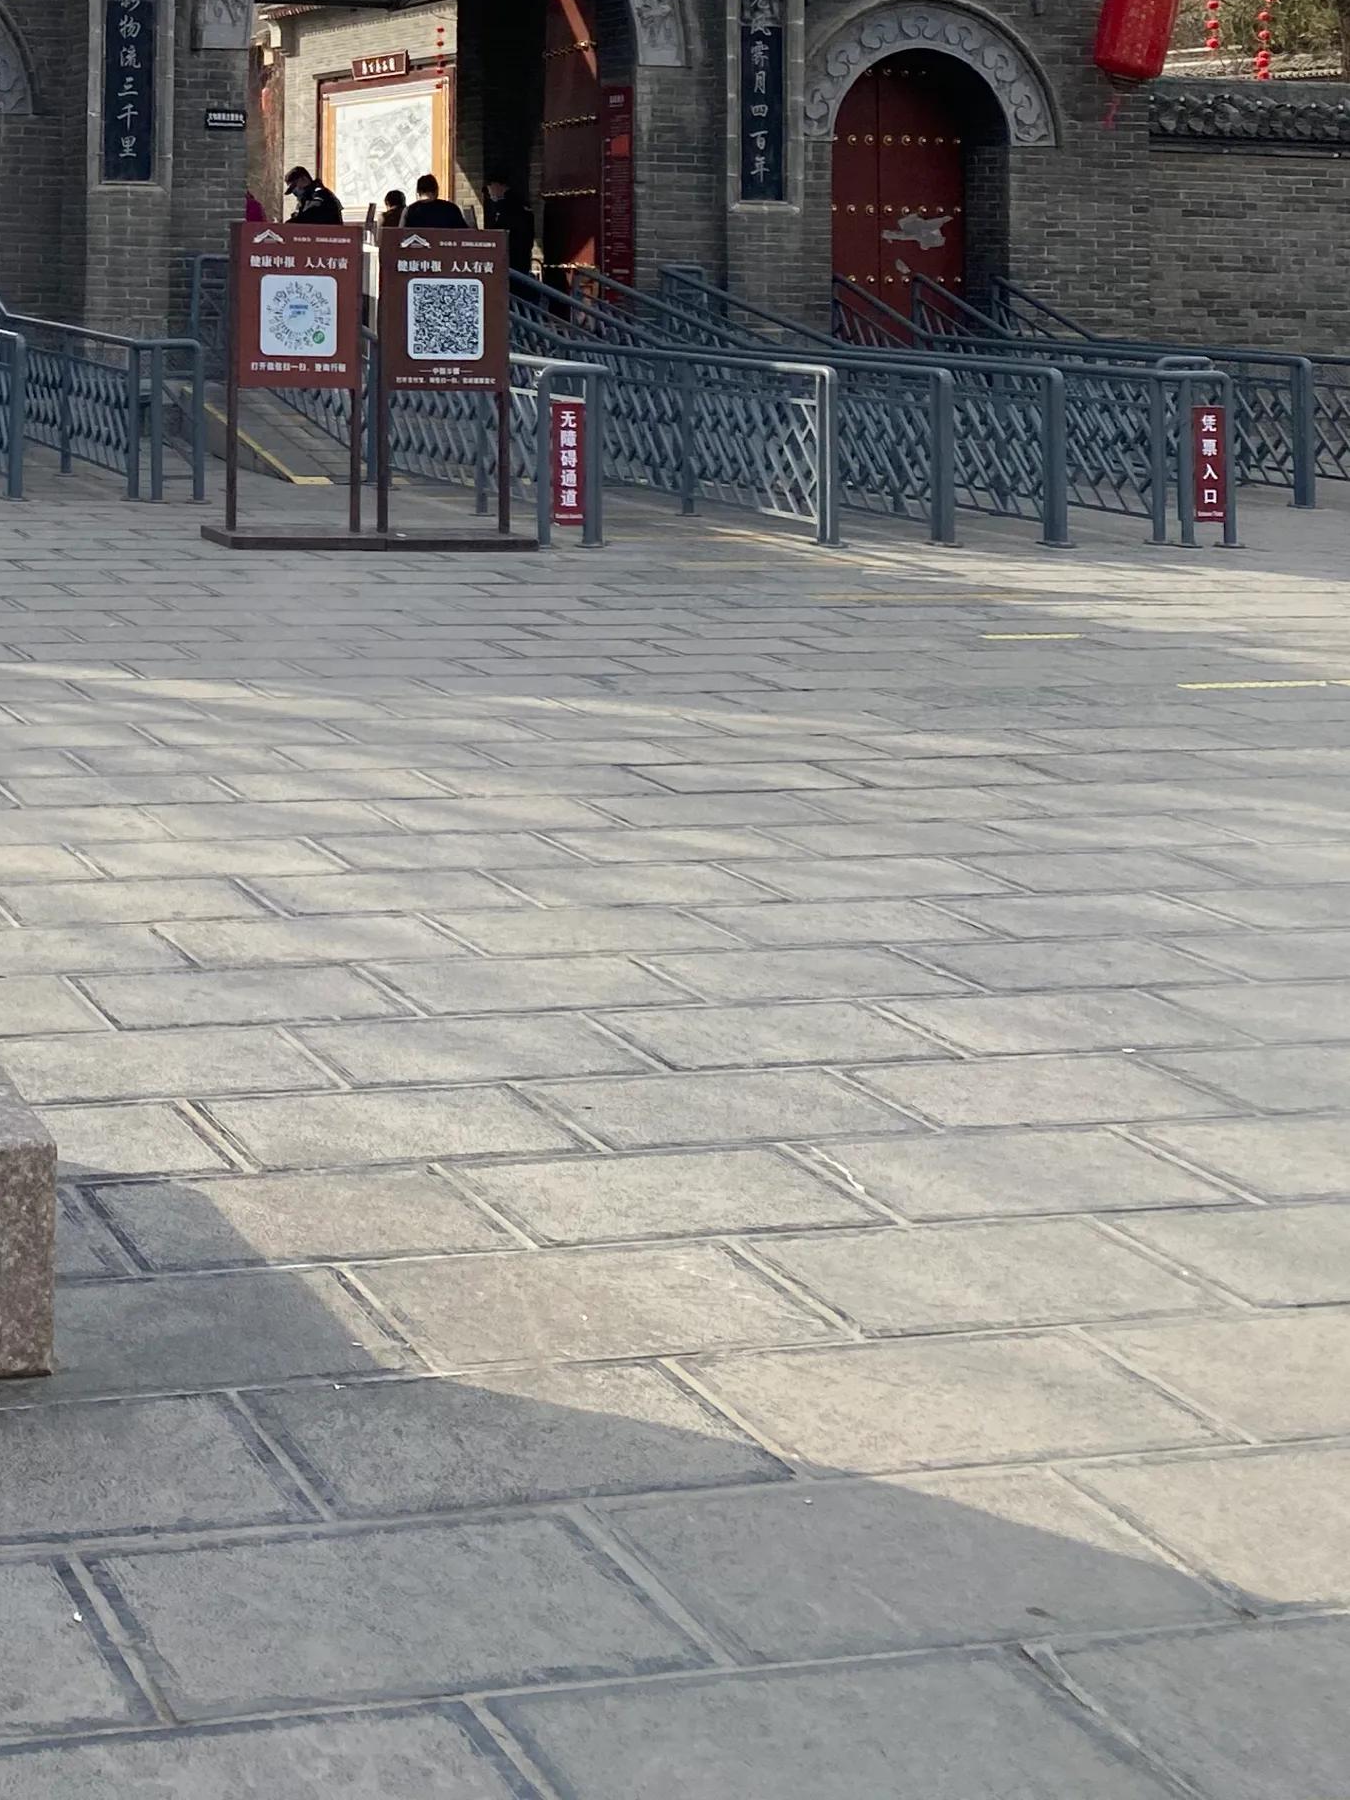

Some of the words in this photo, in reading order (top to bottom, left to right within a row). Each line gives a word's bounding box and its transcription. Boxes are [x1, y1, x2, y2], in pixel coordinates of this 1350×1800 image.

[250, 254, 296, 269] 健康申报
[397, 259, 442, 273] 健康申报
[559, 410, 579, 508] 无障碍通道
[1201, 414, 1219, 505] 凭票入口
